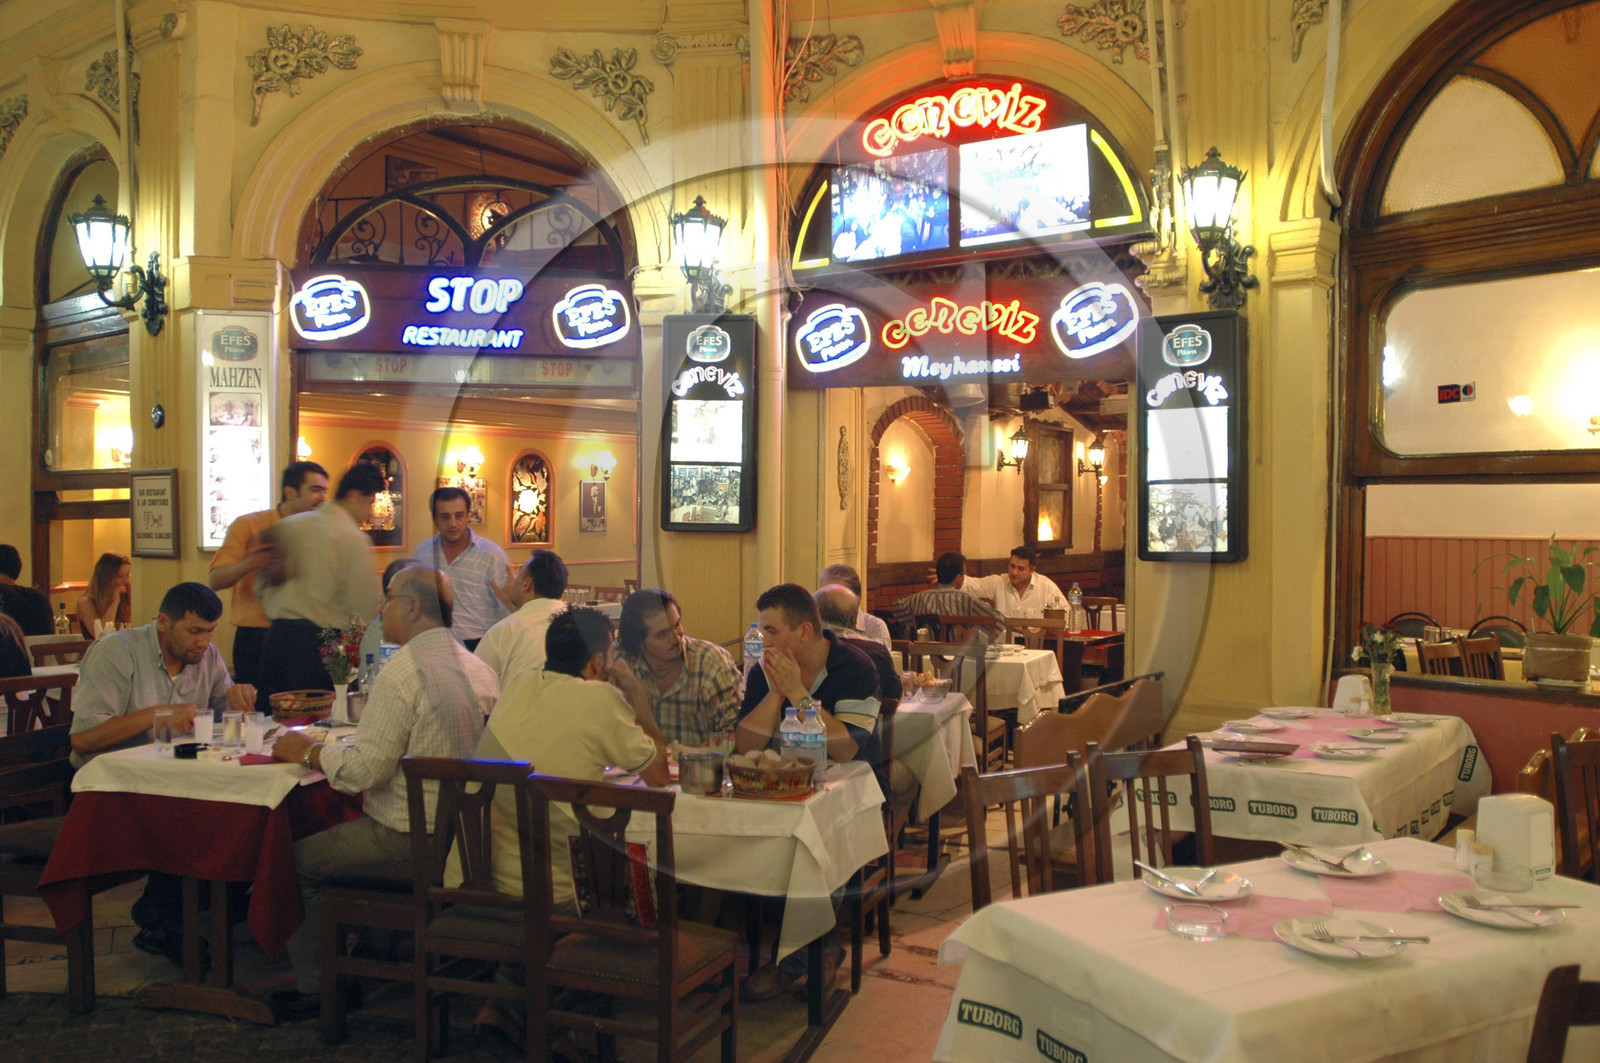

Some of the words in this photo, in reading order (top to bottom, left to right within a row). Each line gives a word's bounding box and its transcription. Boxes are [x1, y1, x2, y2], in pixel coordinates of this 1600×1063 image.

[425, 276, 523, 314] STOP
[220, 334, 251, 346] EFES
[402, 325, 524, 348] RESTAURANT
[695, 335, 723, 346] EFES
[1173, 335, 1203, 349] EFES
[375, 357, 407, 373] STOP
[542, 361, 572, 377] STOP
[209, 366, 262, 389] MAHZEN
[1460, 747, 1477, 780] TUBORG
[1251, 802, 1295, 817] TUBORG
[1314, 809, 1356, 823] TUBORG
[962, 1004, 1020, 1036] TUBORG
